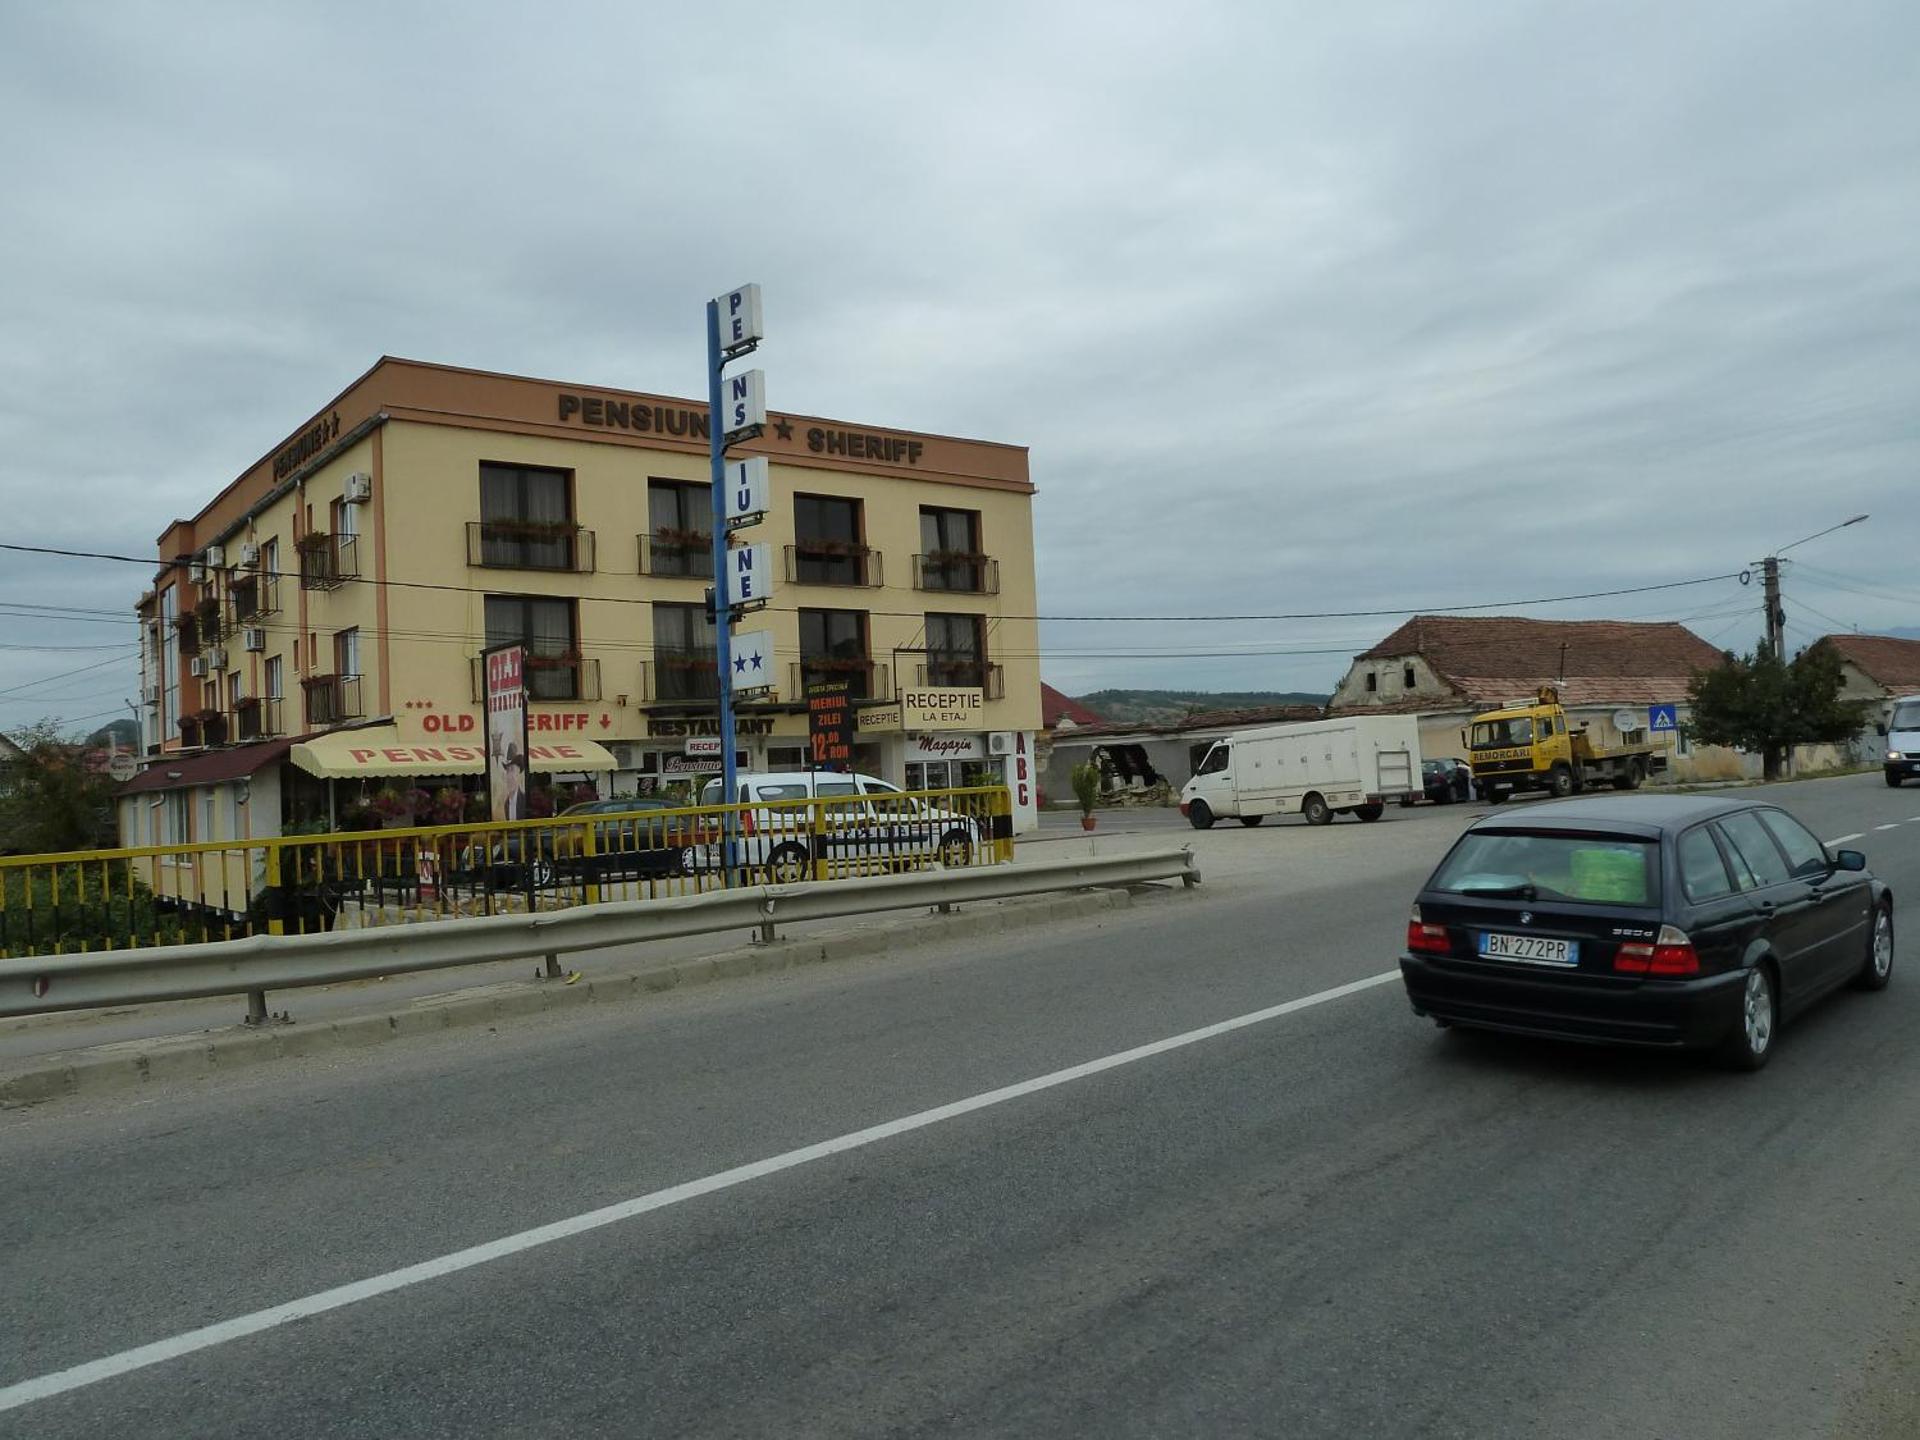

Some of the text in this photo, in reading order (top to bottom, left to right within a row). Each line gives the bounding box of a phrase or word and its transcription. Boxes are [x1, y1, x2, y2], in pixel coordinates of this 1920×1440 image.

[558, 393, 923, 463] PENSIUN SHERIFF
[490, 650, 522, 691] OLD
[811, 696, 848, 710] MENIUL
[906, 693, 981, 709] RECEPTIE
[422, 714, 589, 733] OLD ERIFF
[859, 712, 899, 726] RECEPTIE
[922, 712, 967, 722] LA ETAJ
[647, 719, 775, 736] RESTAUANT
[349, 745, 584, 763] PENSNE
[689, 742, 720, 751] RECEP
[918, 736, 972, 755] Magazin
[1474, 748, 1530, 761] REMORCARI
[1016, 732, 1029, 806] ABC
